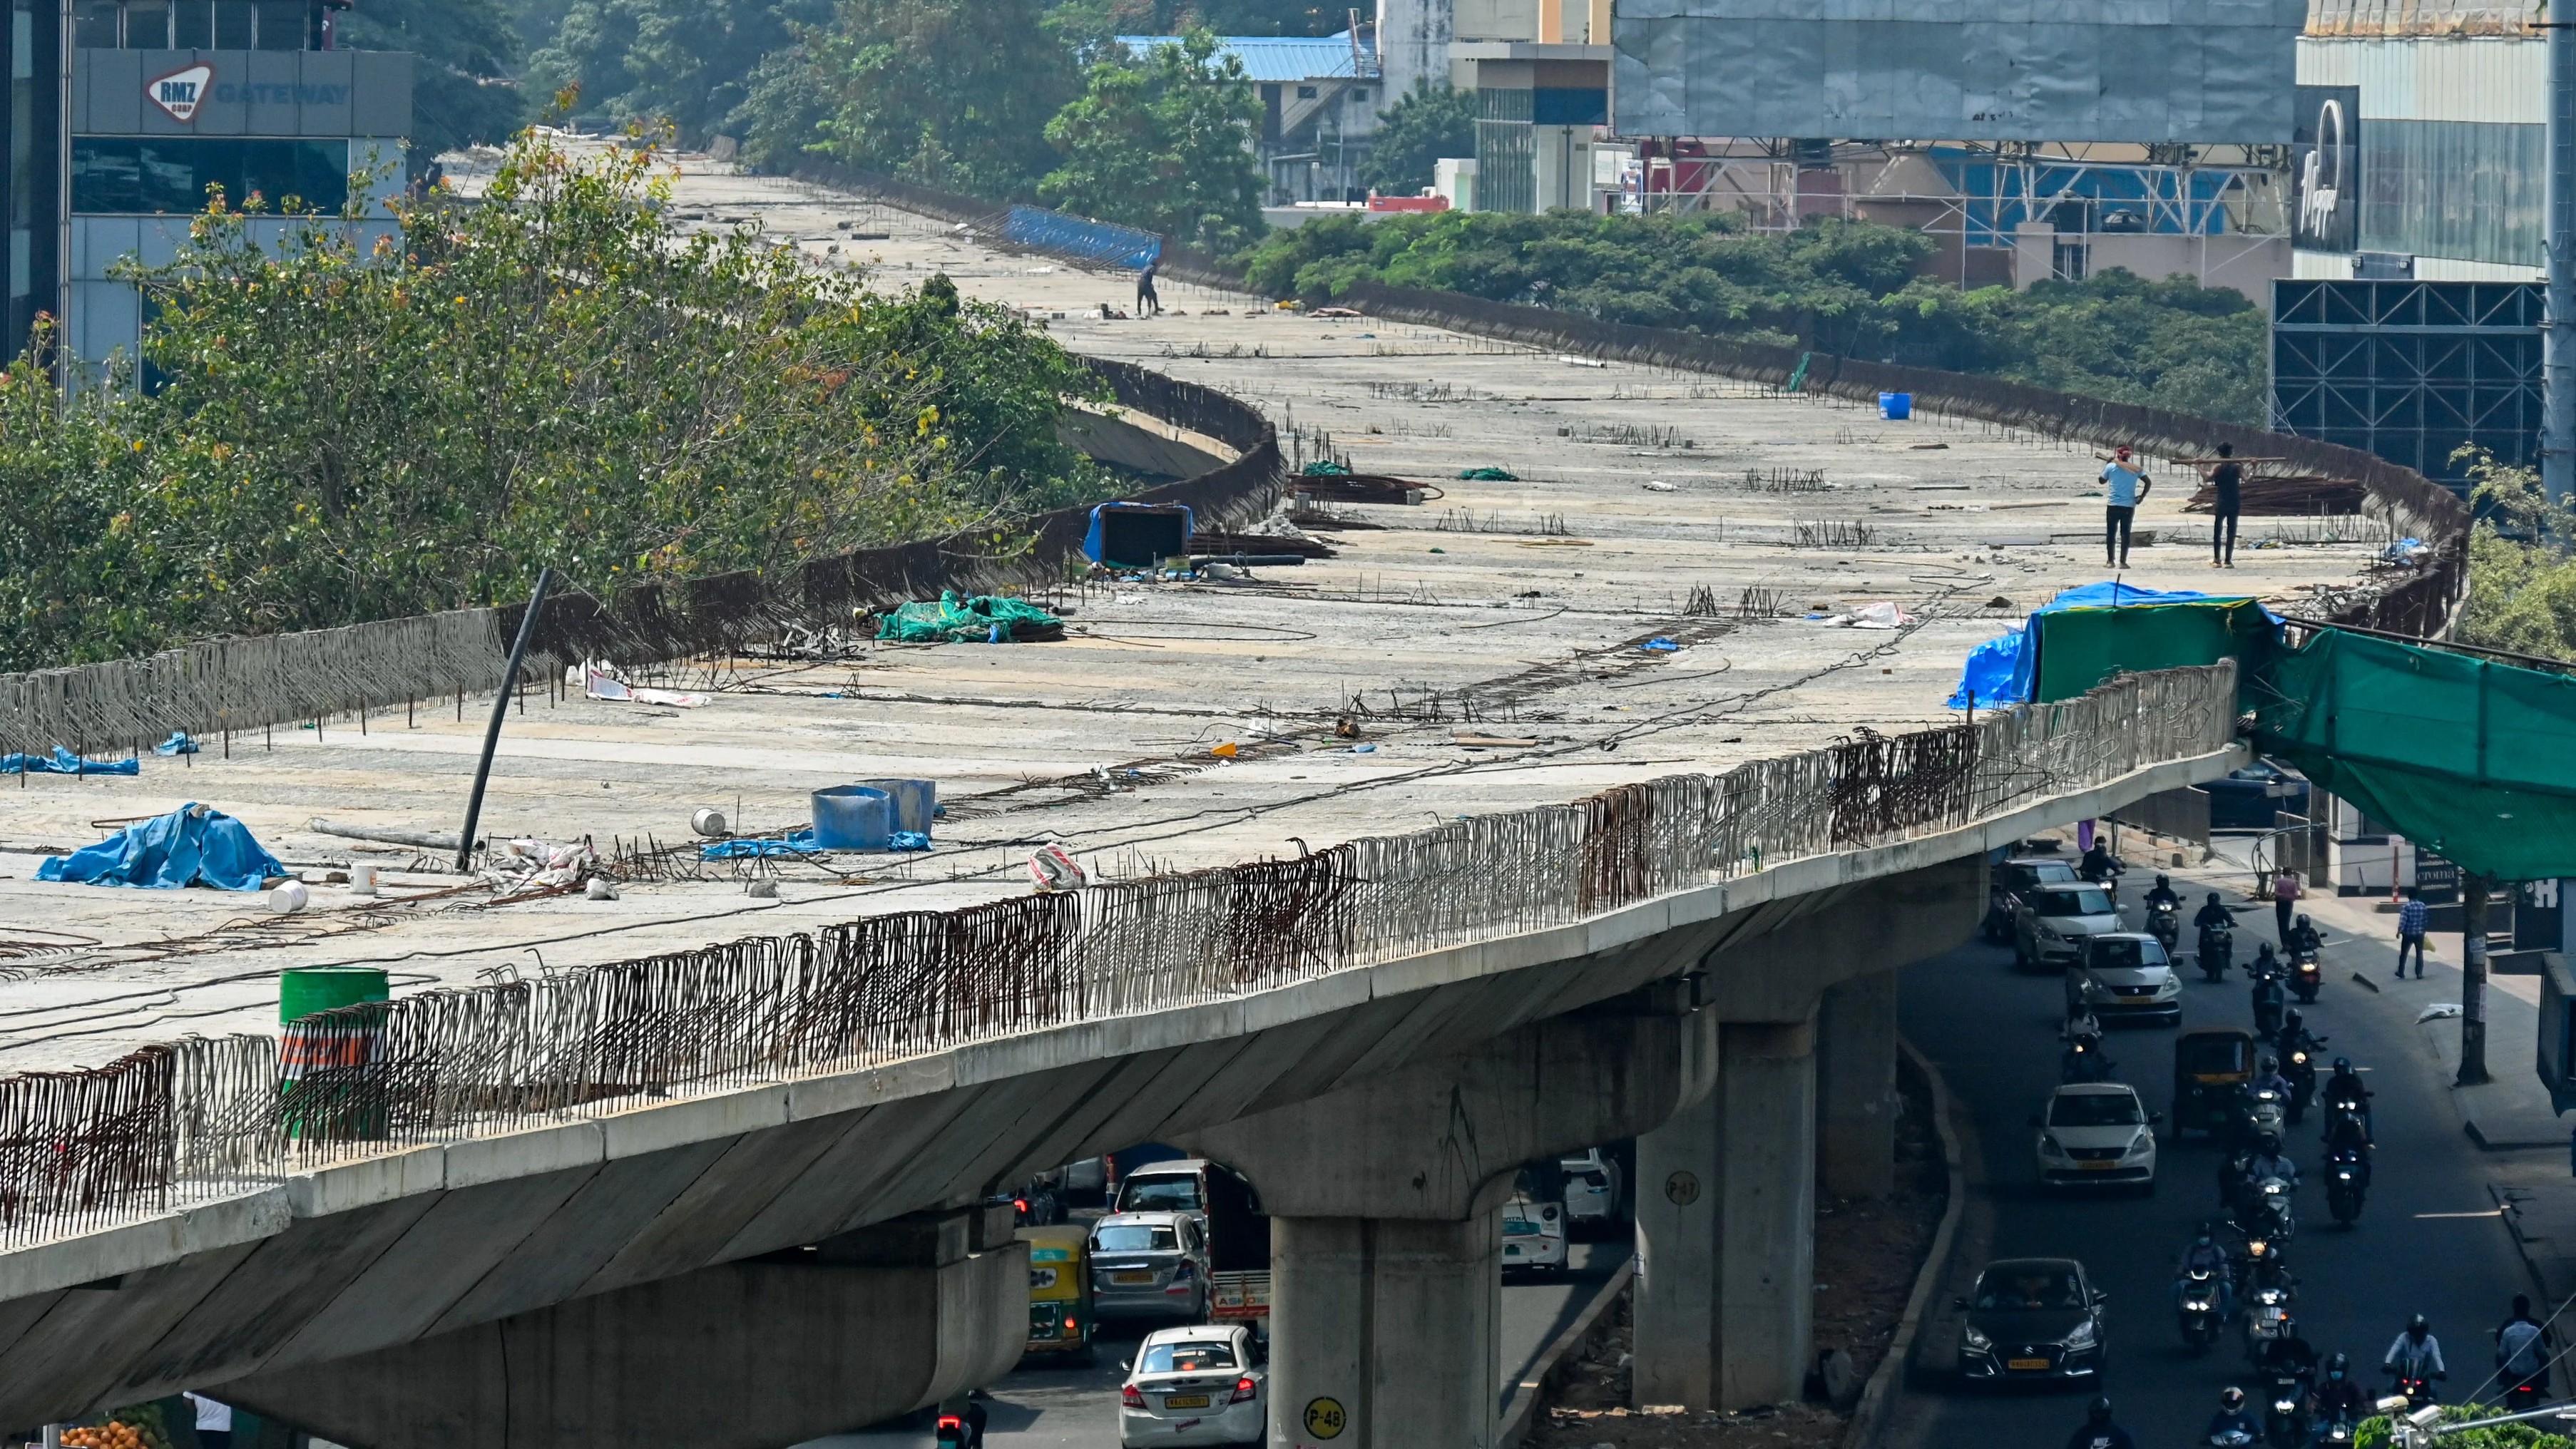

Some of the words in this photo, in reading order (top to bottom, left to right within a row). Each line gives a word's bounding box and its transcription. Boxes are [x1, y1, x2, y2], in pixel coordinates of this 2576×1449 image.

[160, 82, 196, 103] RMZ
[215, 83, 349, 104] GATEWAY
[171, 104, 193, 113] CORP
[2417, 870, 2455, 881] croma
[1309, 1409, 1341, 1428] P-48
